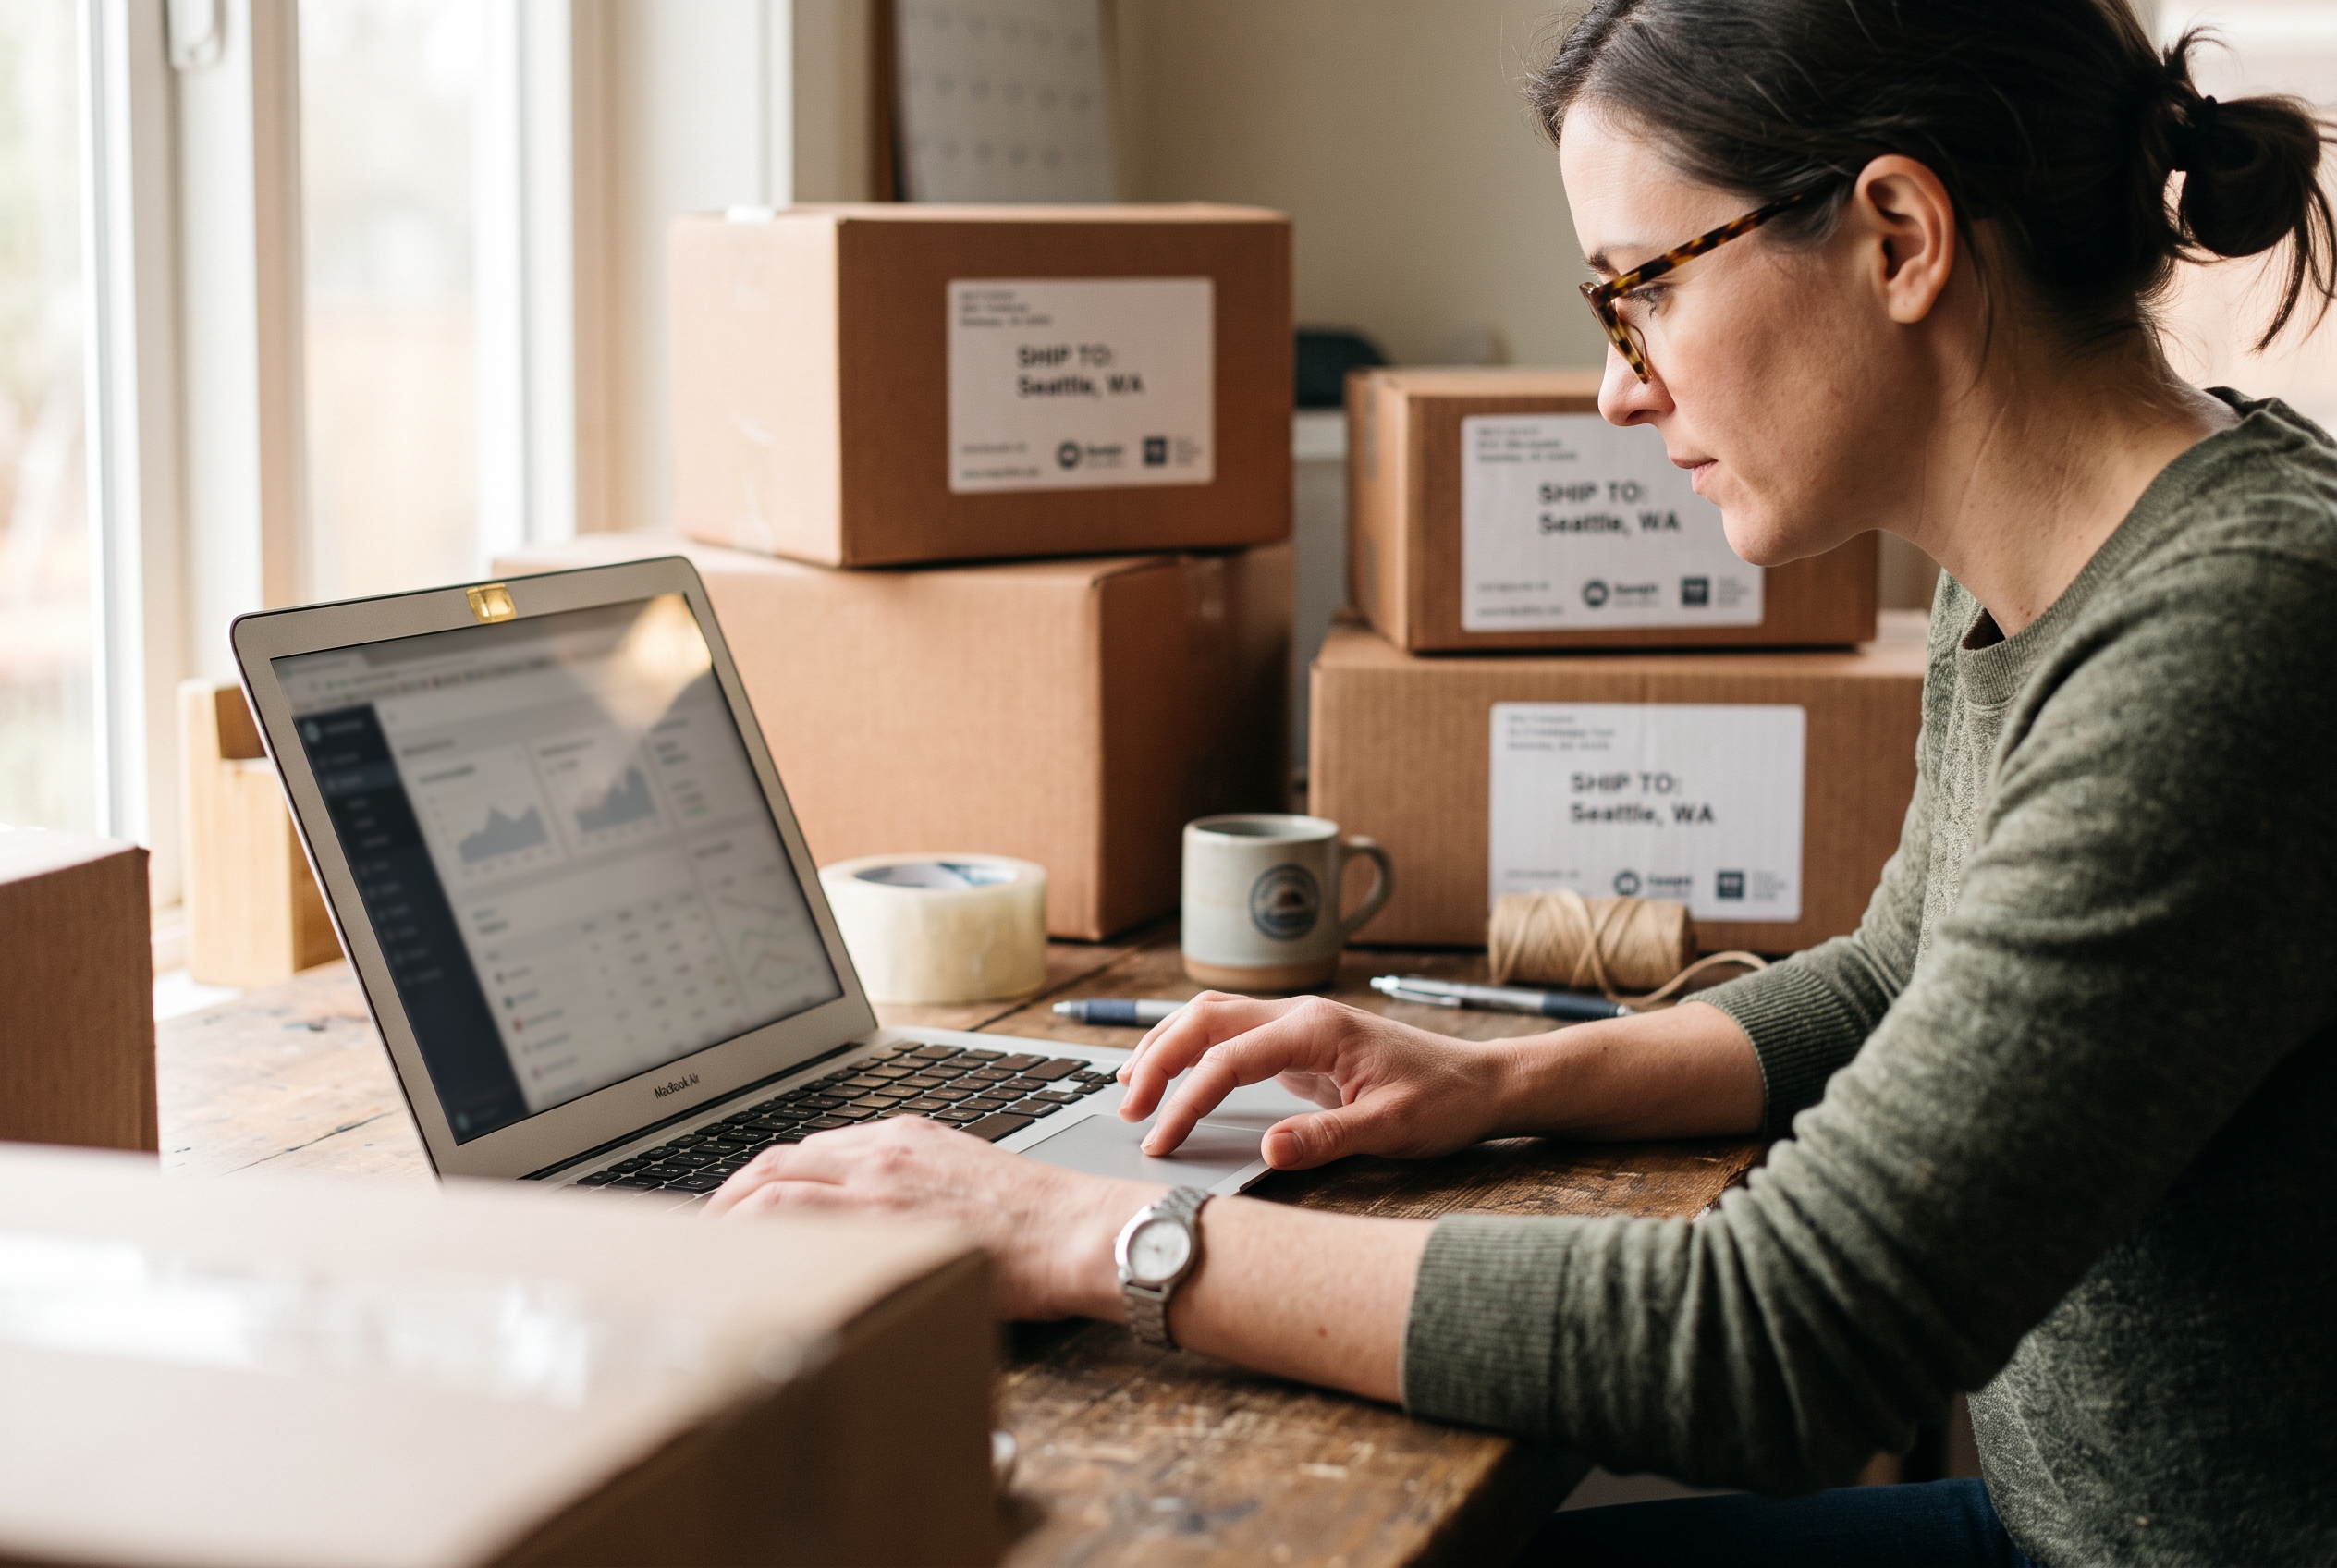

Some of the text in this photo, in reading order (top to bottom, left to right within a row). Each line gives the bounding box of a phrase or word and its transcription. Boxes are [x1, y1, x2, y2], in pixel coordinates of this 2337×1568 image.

[1019, 345, 1071, 366] SHIP
[1107, 374, 1144, 393] WA
[1539, 483, 1597, 504] SHIP
[1540, 511, 1680, 536] Seattle, WA
[1572, 772, 1681, 795] SHIP TO:
[1572, 803, 1713, 827] Seattle, WA
[654, 1076, 690, 1099] MacBook
